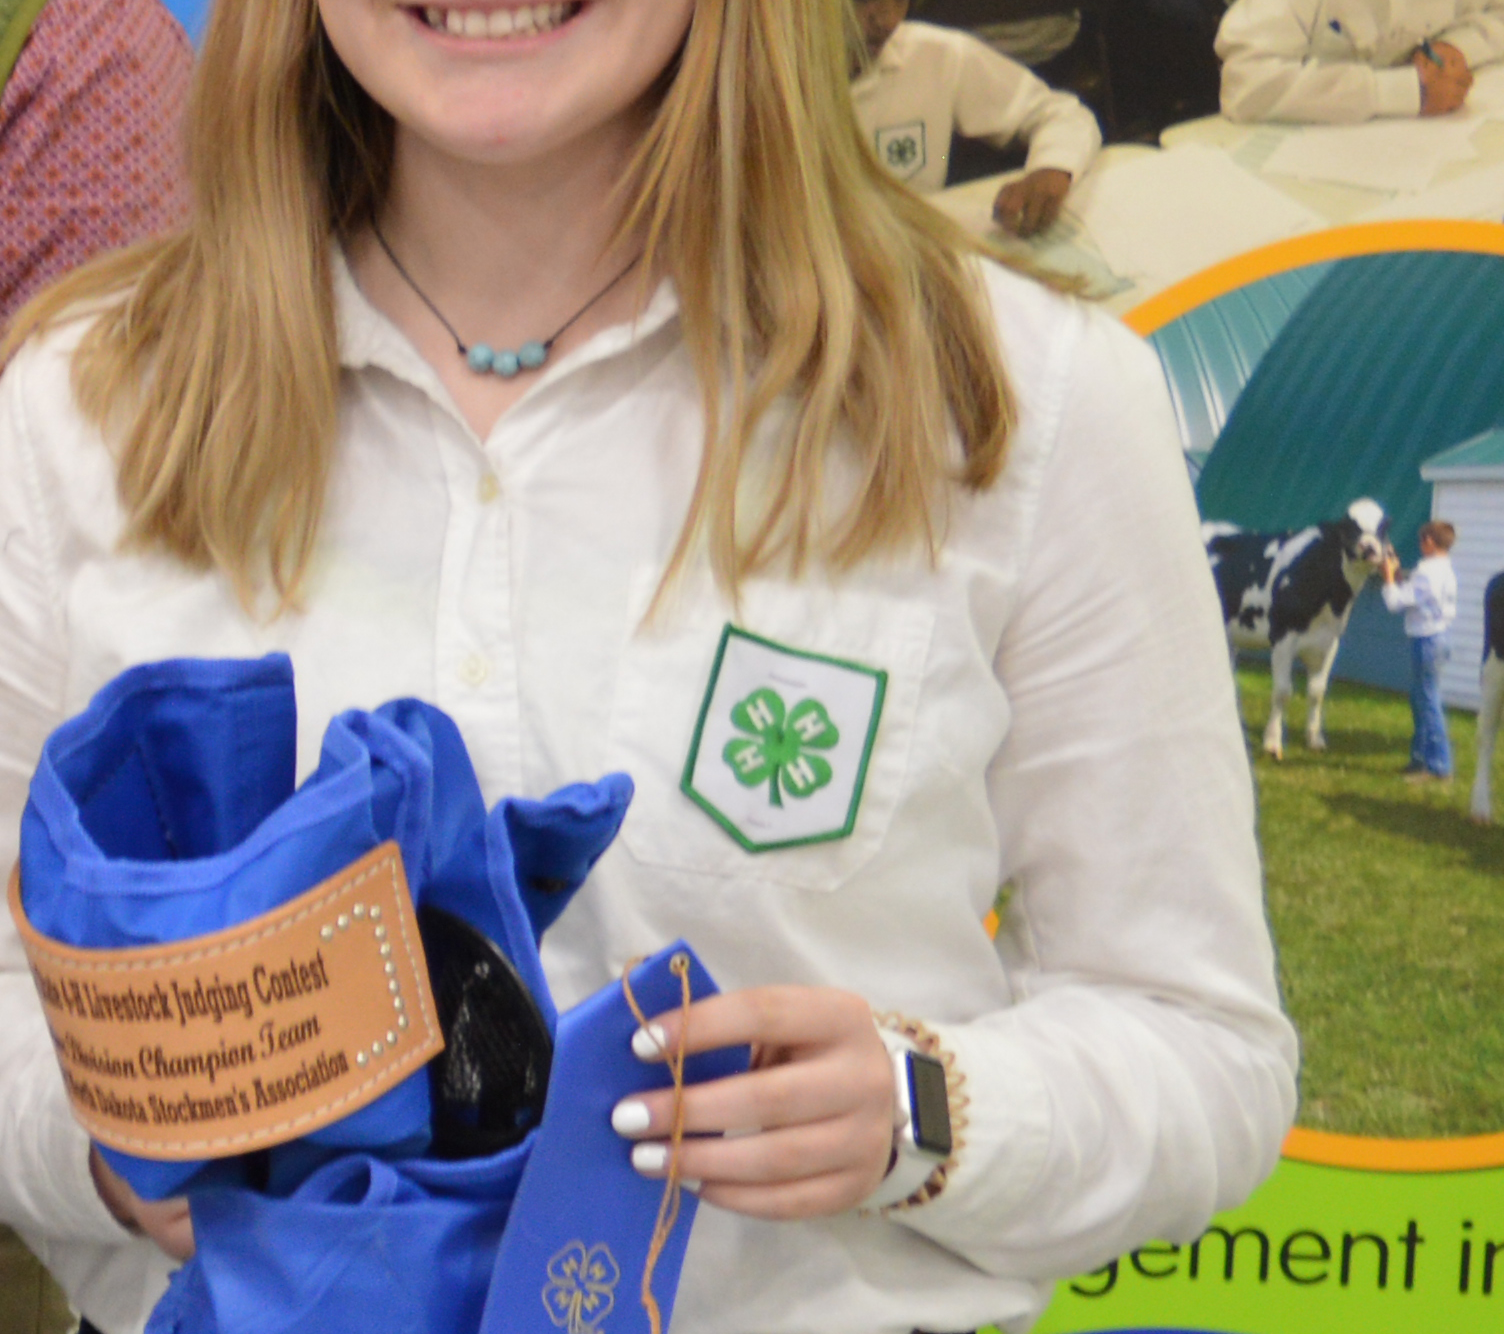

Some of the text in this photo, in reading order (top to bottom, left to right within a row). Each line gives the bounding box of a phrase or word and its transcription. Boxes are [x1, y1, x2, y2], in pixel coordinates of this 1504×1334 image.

[84, 979, 174, 1023] Livestock
[171, 972, 255, 1027] Judging
[253, 948, 330, 1005] Contest
[138, 1038, 256, 1084] Champion
[259, 1014, 322, 1061] Team
[148, 1085, 251, 1127] Stockmen's
[253, 1050, 349, 1111] Association
